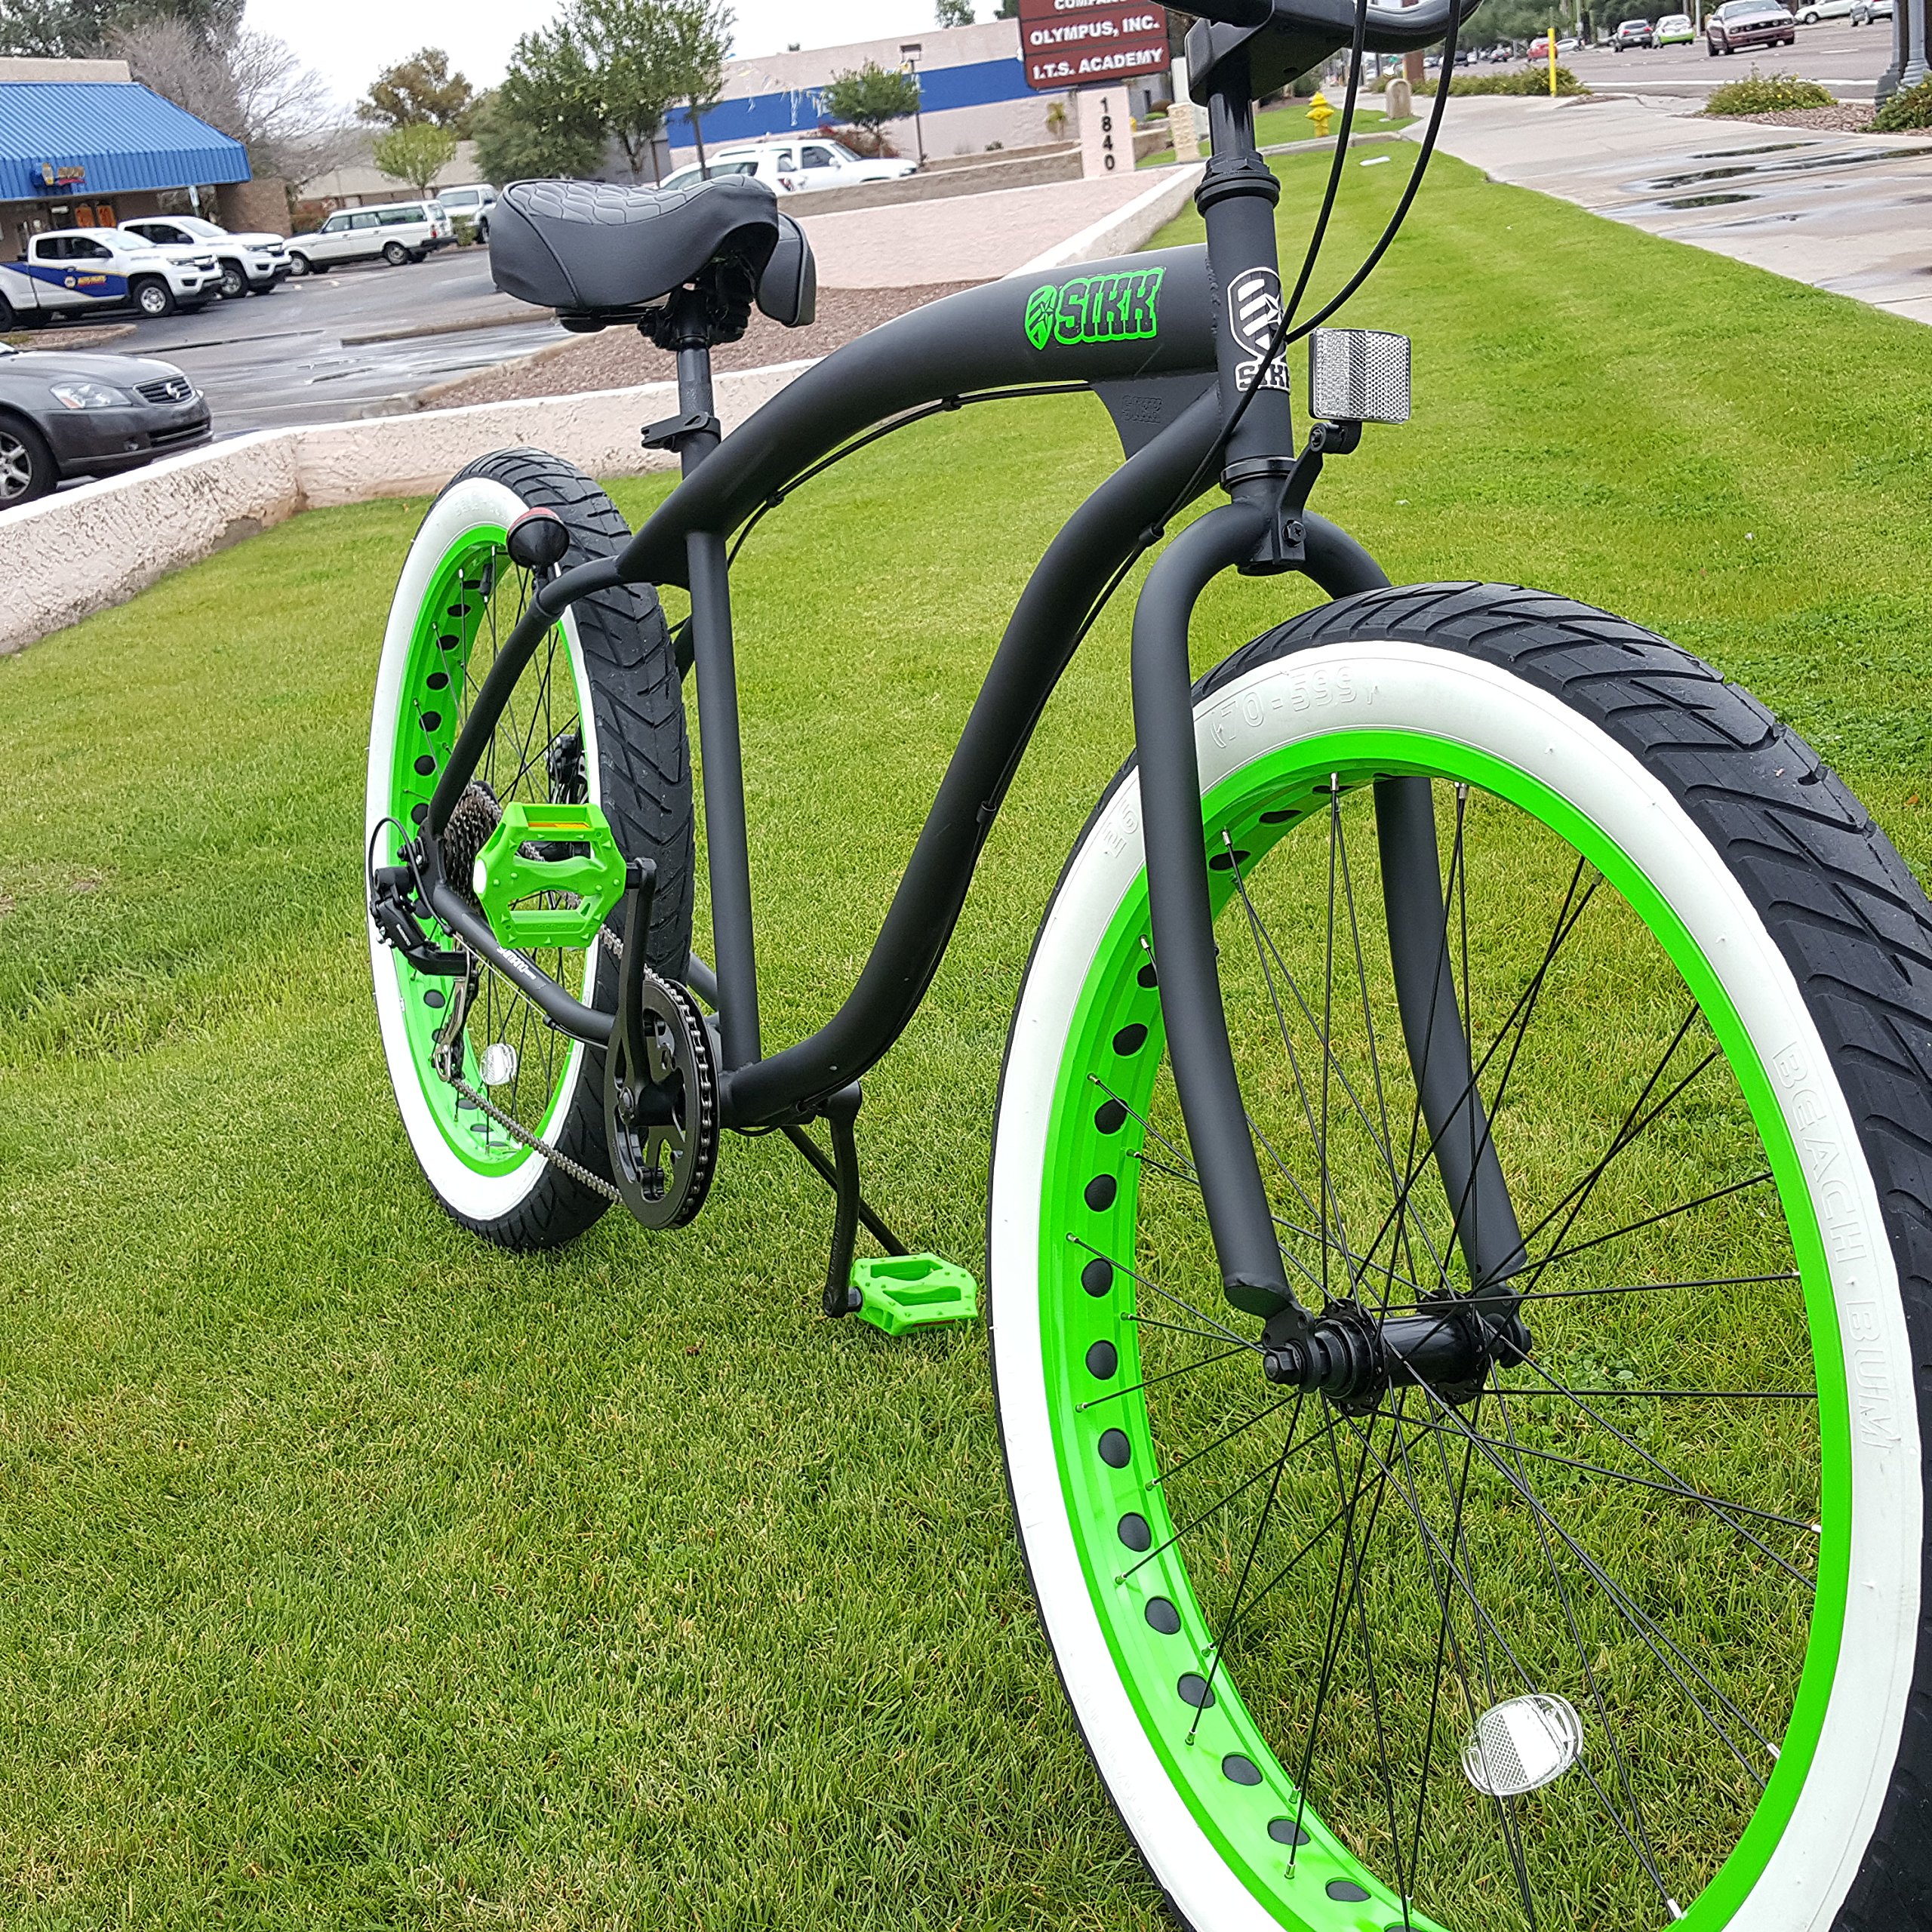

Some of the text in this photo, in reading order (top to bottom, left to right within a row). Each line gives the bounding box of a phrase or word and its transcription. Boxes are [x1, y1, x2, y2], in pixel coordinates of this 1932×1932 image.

[1030, 15, 1160, 45] OLYMPUS, INC.
[1032, 47, 1163, 79] I.T.S. ACADEMY
[1100, 97, 1115, 171] 1840
[1054, 267, 1166, 344] SIKK
[1773, 1041, 1896, 1449] BEACH BUM
